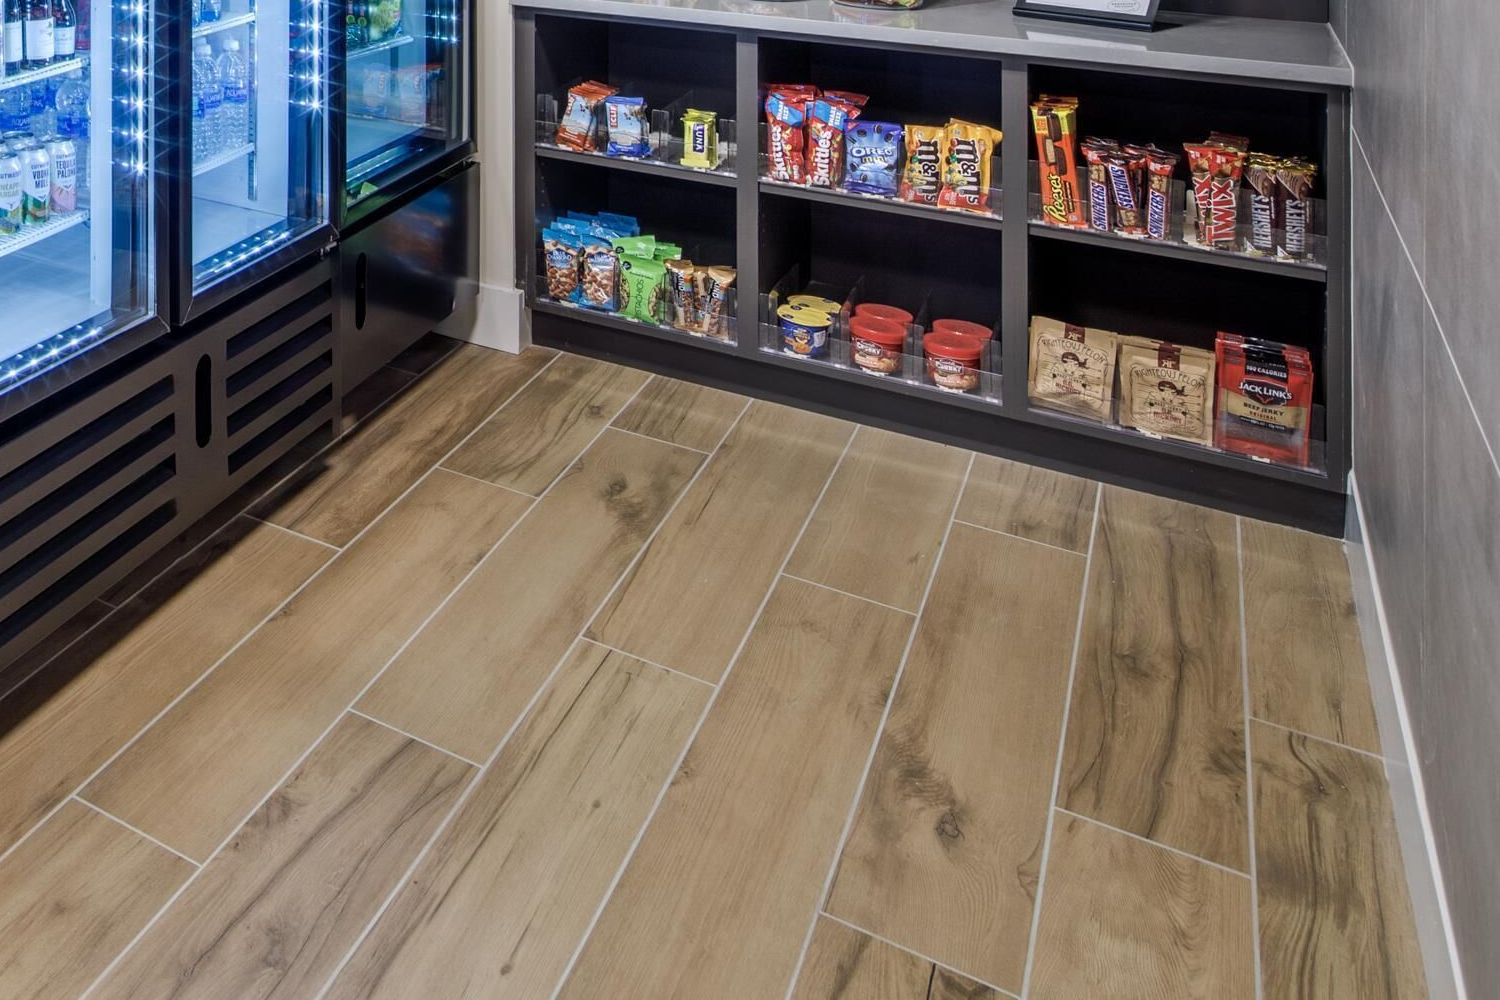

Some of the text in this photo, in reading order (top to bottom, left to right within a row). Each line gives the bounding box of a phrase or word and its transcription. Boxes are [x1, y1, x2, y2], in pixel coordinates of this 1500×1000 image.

[610, 104, 618, 128] CLIF
[828, 106, 842, 126] SHARE SIZE
[694, 124, 704, 151] LUNA
[772, 125, 789, 180] Skittles
[813, 130, 833, 185] Skittles
[852, 147, 894, 157] OREO
[1110, 166, 1134, 209] SNICKERS
[1091, 181, 1107, 231] SNICKERS
[1148, 191, 1165, 238] SNICKERS
[1206, 179, 1236, 246] TWIX
[1251, 194, 1272, 248] HERSHEY'S
[1285, 200, 1305, 253] HERSHEY'S
[634, 279, 645, 317] STACHIOS
[711, 279, 721, 298] KIND
[1041, 339, 1106, 363] RIGHTEOUS FELON
[1134, 367, 1204, 390] RIGHTEOUS FELON
[1257, 367, 1287, 379] CALORIES
[1238, 381, 1293, 400] JACK LINK'S
[1243, 401, 1285, 417] BEEF JERKY
[1248, 410, 1278, 422] ORIGINAL
